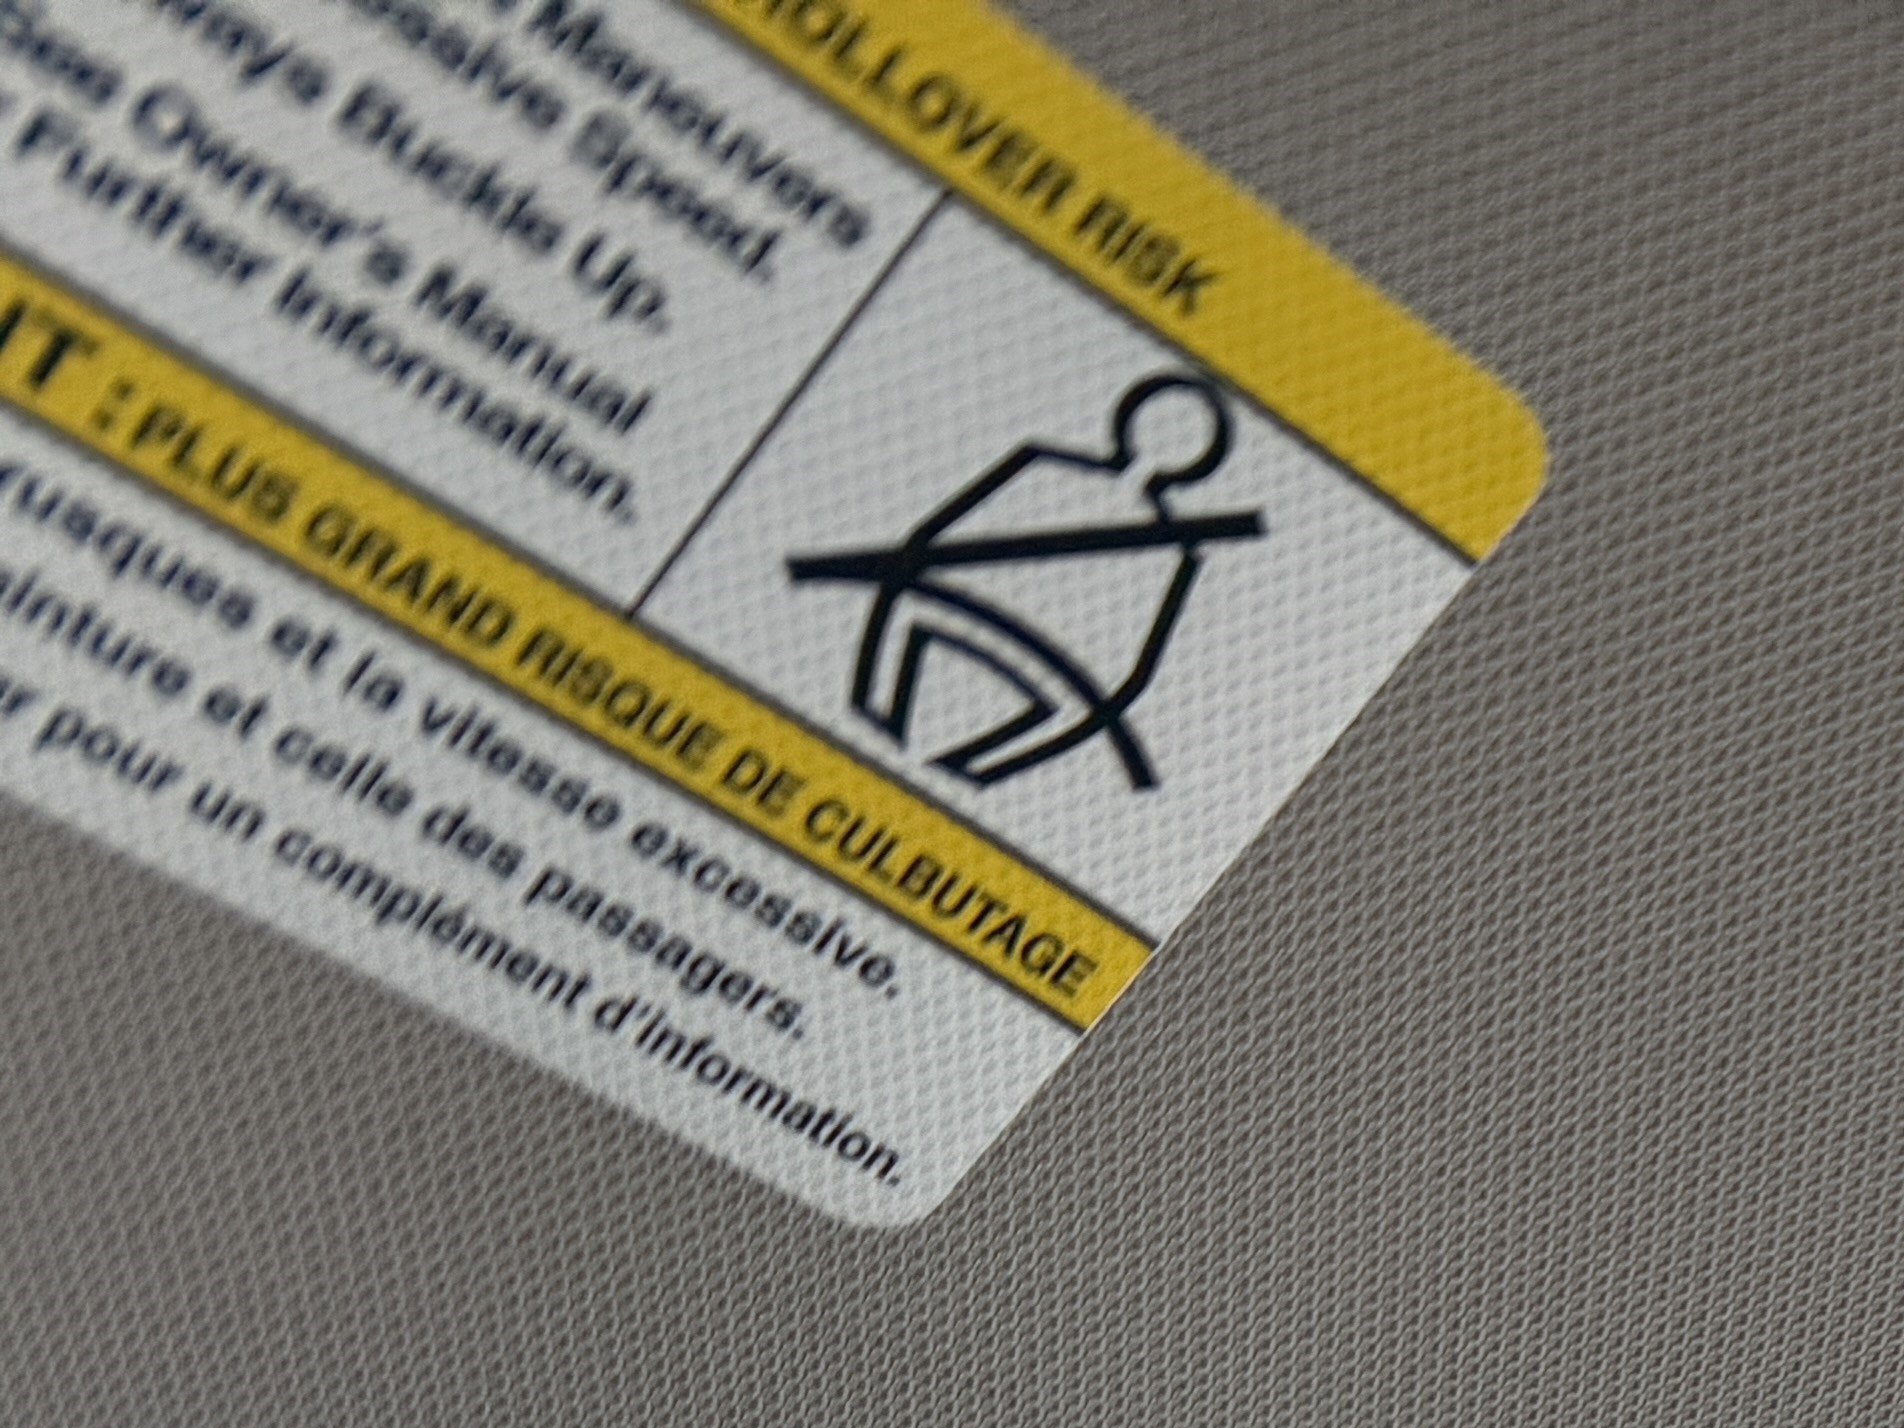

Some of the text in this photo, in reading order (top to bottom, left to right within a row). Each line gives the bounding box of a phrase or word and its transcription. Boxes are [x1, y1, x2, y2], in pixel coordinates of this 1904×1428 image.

[15, 109, 633, 524] Further Information.
[130, 85, 409, 289] Owner's
[415, 265, 653, 436] Manual
[338, 85, 564, 256] Buckle
[1073, 193, 1215, 316] RISK
[130, 404, 299, 526] PLUS
[303, 505, 516, 649] GRAND
[515, 627, 722, 770] RISQUE
[720, 748, 806, 818] DE
[803, 798, 1099, 998] CULBUTAGE
[200, 686, 270, 741] et
[272, 727, 415, 819] celle
[420, 804, 525, 881] des
[523, 866, 806, 1040] passagers.
[268, 618, 338, 675] et
[343, 651, 405, 713] la
[419, 697, 622, 832] vitesse
[628, 822, 899, 1000] excessive.
[34, 706, 183, 794] pour
[188, 783, 265, 842] un
[273, 829, 592, 1014] complément
[592, 995, 900, 1187] d'information.
